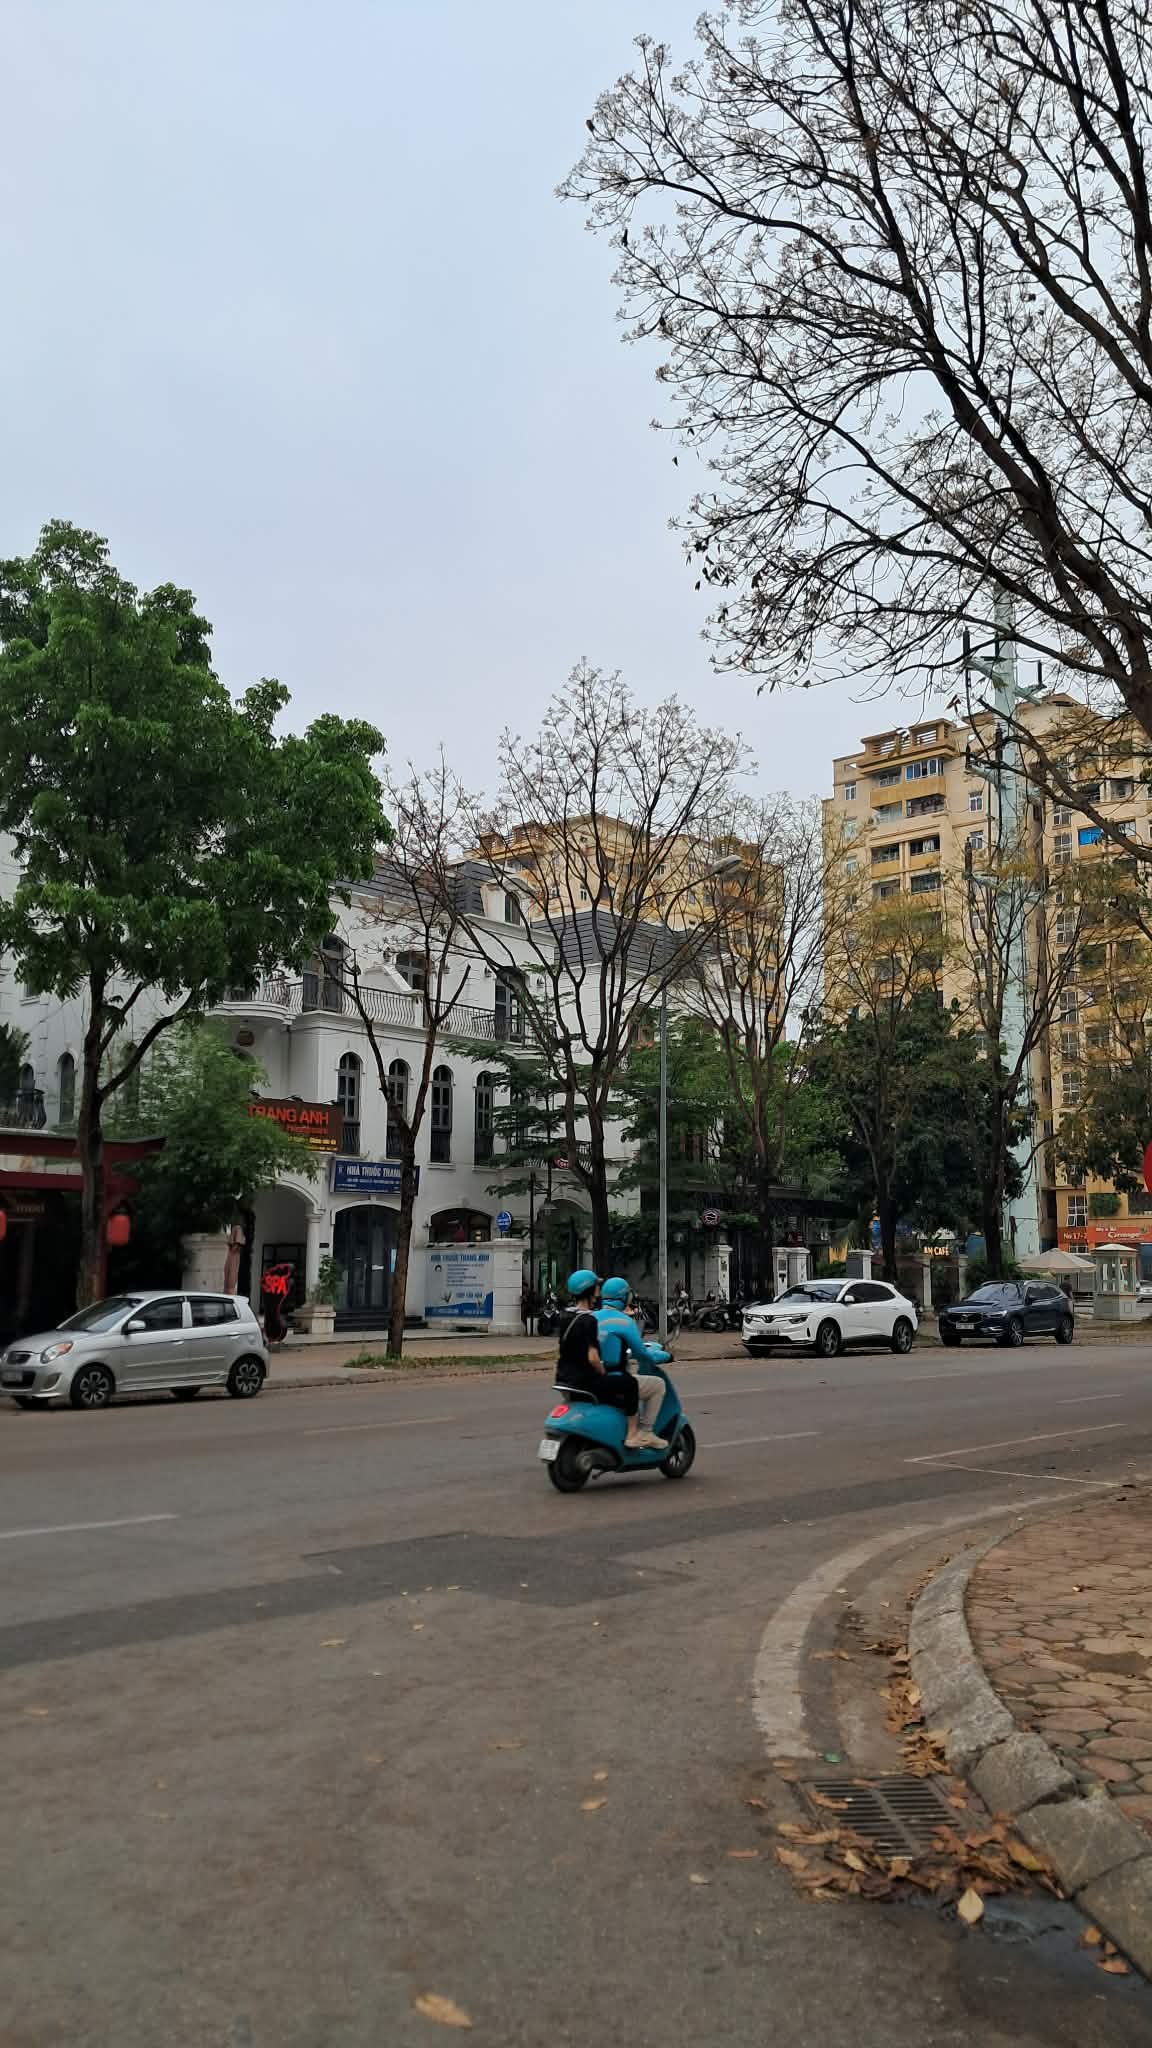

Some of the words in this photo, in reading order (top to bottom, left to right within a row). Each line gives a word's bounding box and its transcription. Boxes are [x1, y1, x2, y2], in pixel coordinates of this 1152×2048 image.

[247, 1104, 297, 1122] TRANG
[299, 1110, 329, 1125] ANH
[262, 1274, 288, 1296] SPA
